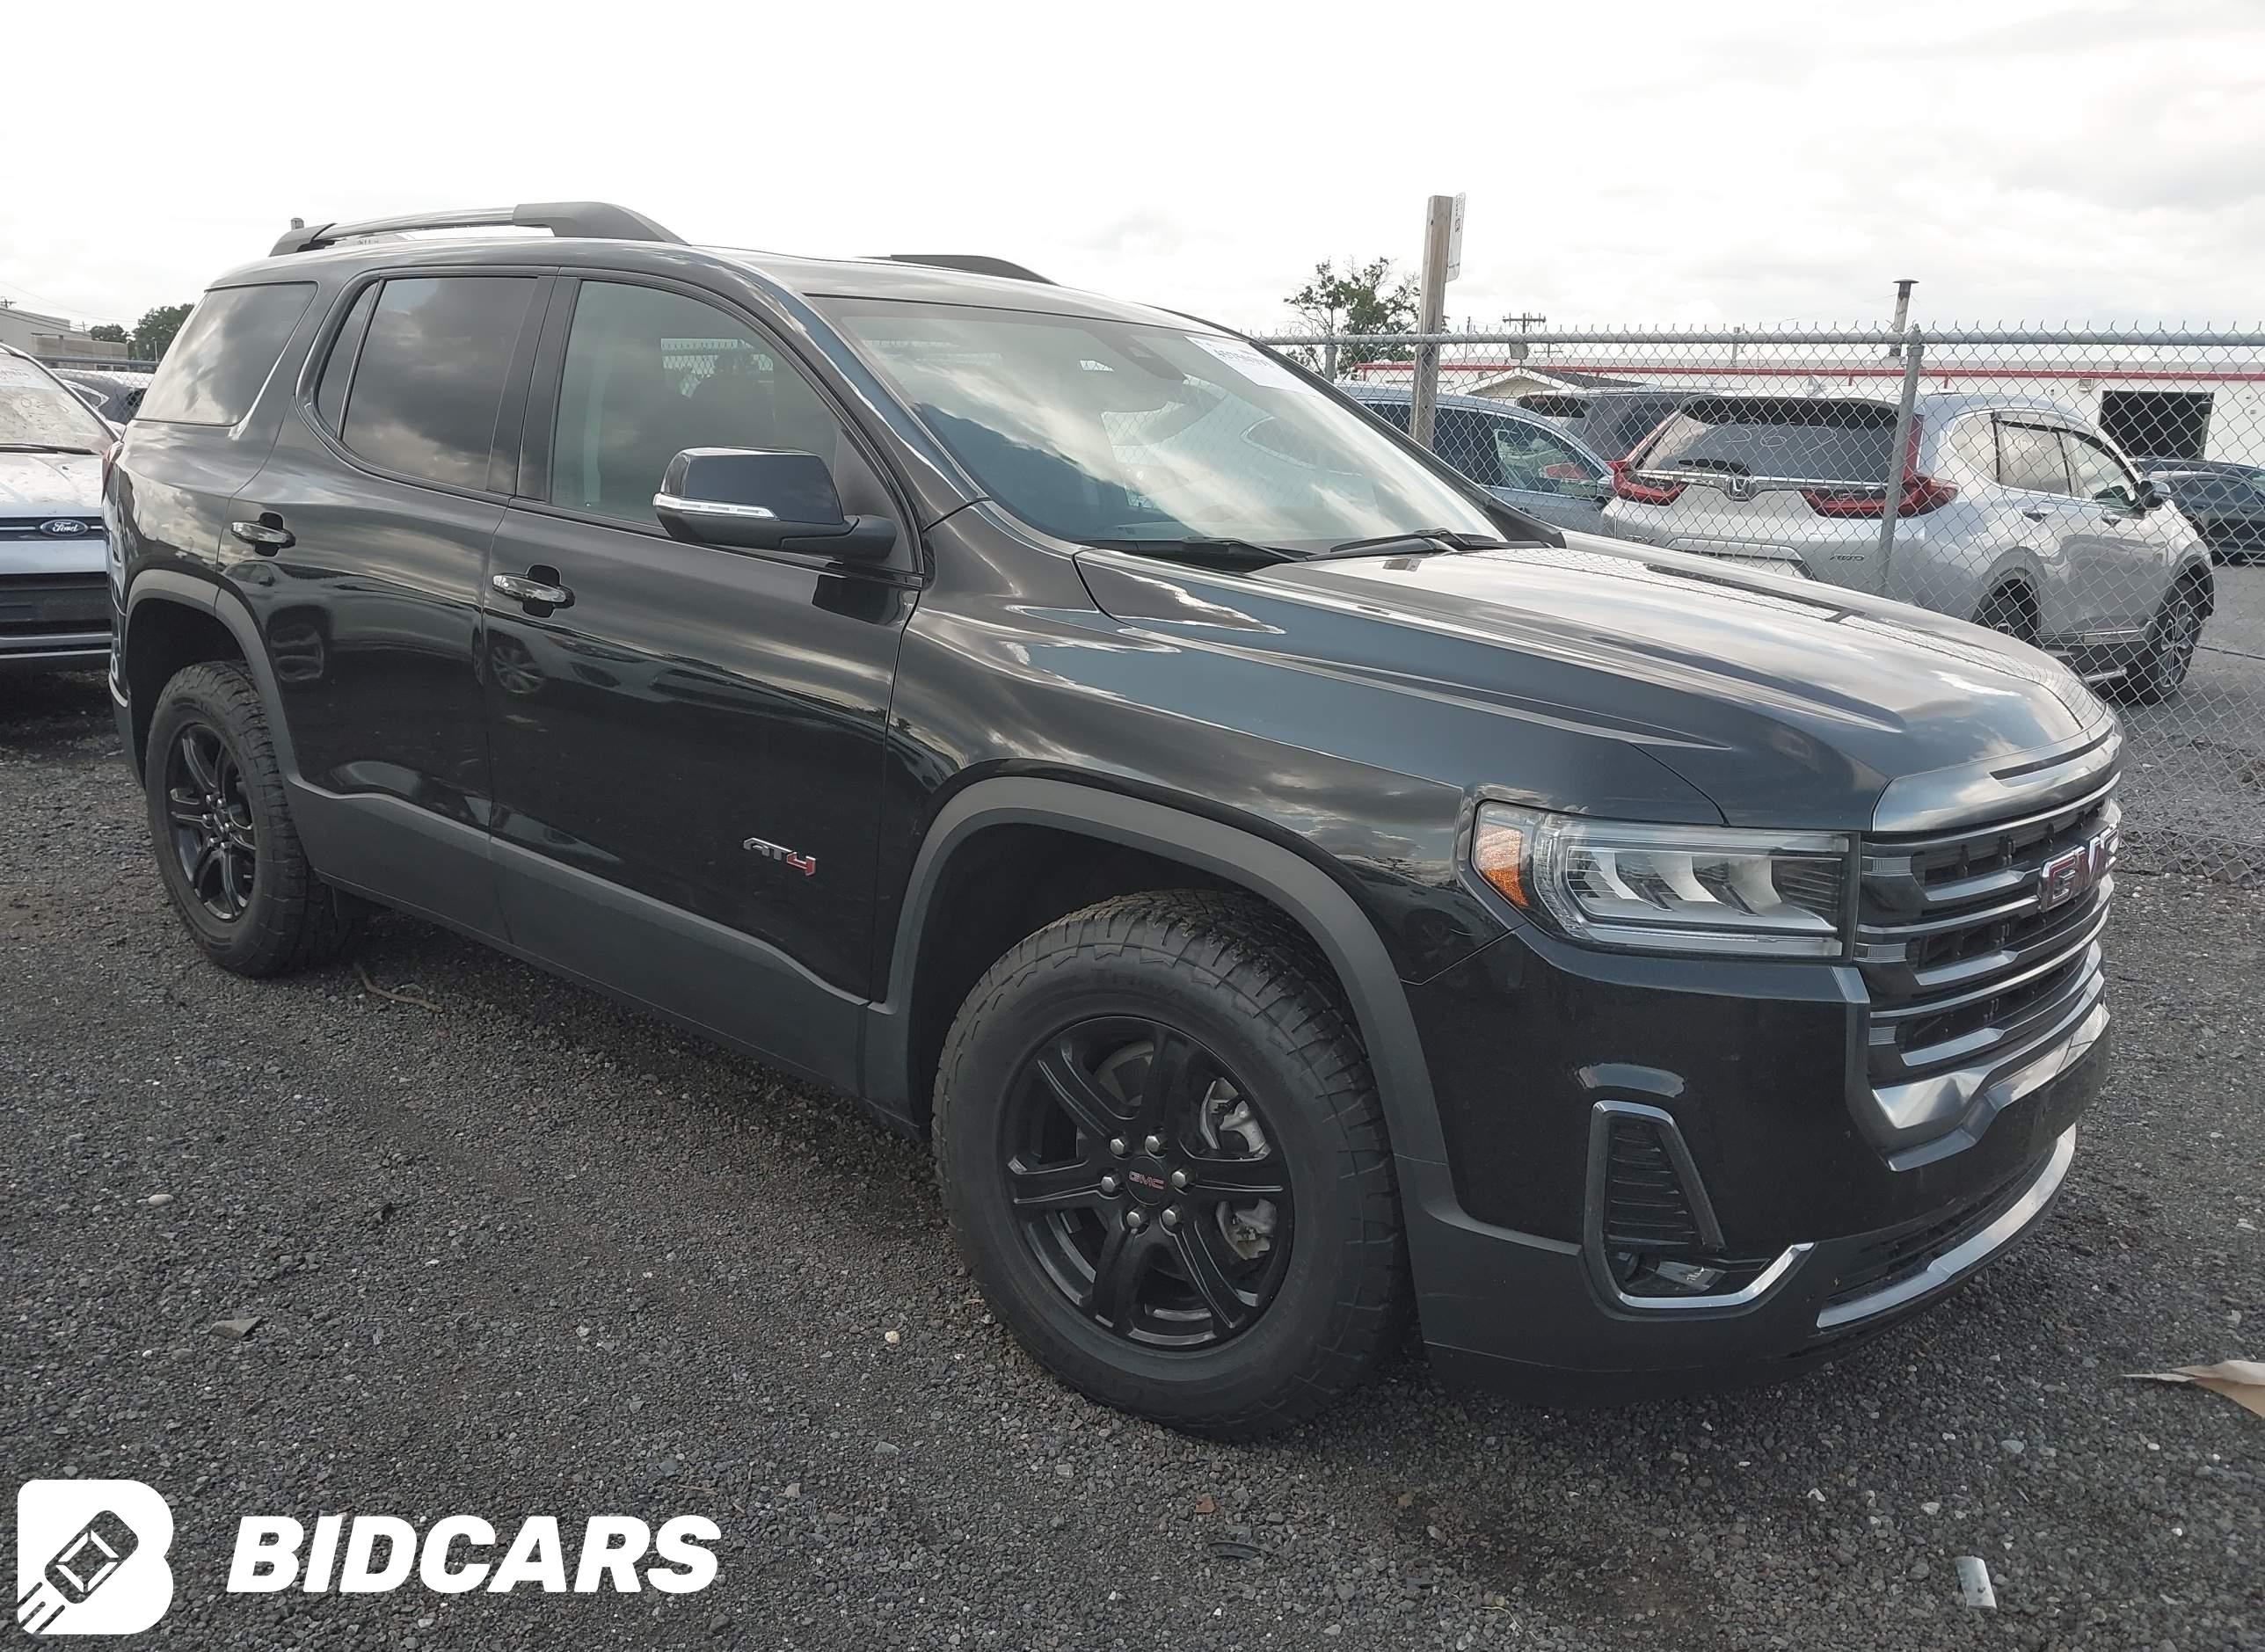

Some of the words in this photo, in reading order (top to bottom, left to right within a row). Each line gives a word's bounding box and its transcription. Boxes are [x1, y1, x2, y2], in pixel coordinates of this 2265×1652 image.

[52, 521, 79, 533] Ford
[1829, 553, 1865, 563] AWD
[743, 837, 817, 877] AT4
[2041, 824, 2120, 913] GMC
[1128, 1170, 1165, 1190] GMC
